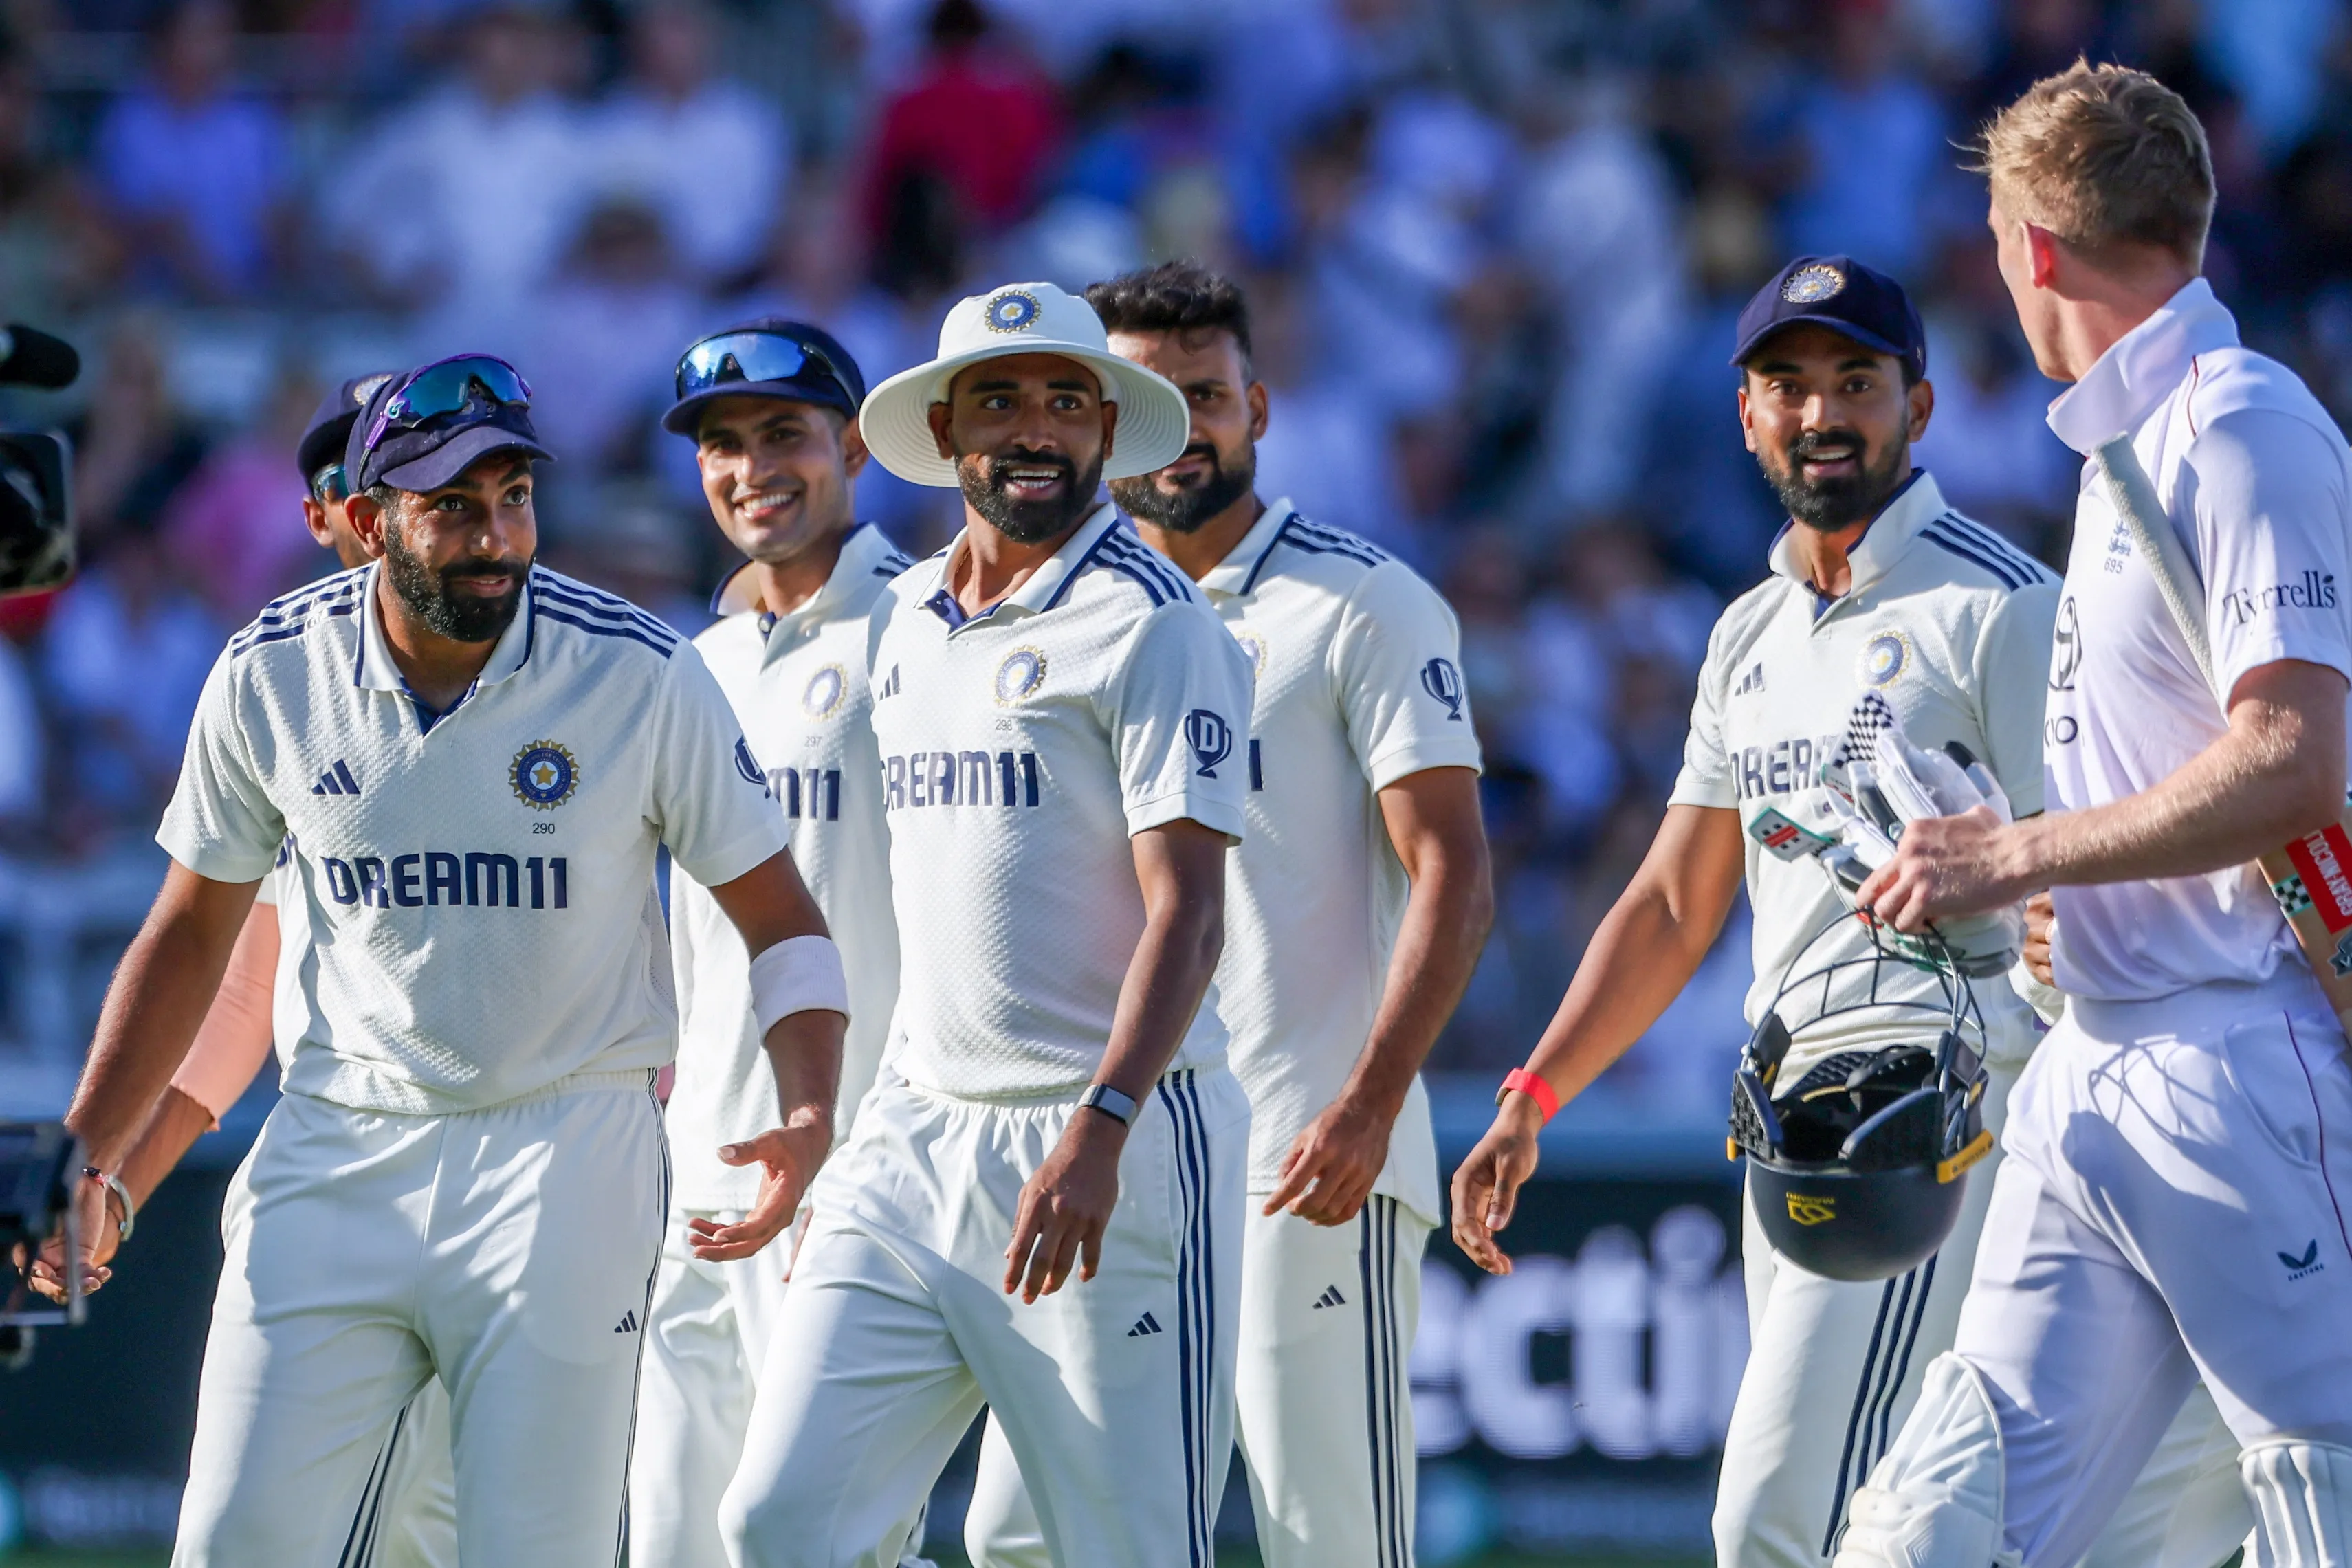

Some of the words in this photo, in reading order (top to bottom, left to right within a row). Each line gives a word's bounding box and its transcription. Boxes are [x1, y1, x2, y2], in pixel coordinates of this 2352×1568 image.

[2104, 557, 2123, 574] 695
[996, 719, 1013, 731] 298
[532, 822, 556, 835] 290
[319, 852, 567, 909] DREAM11
